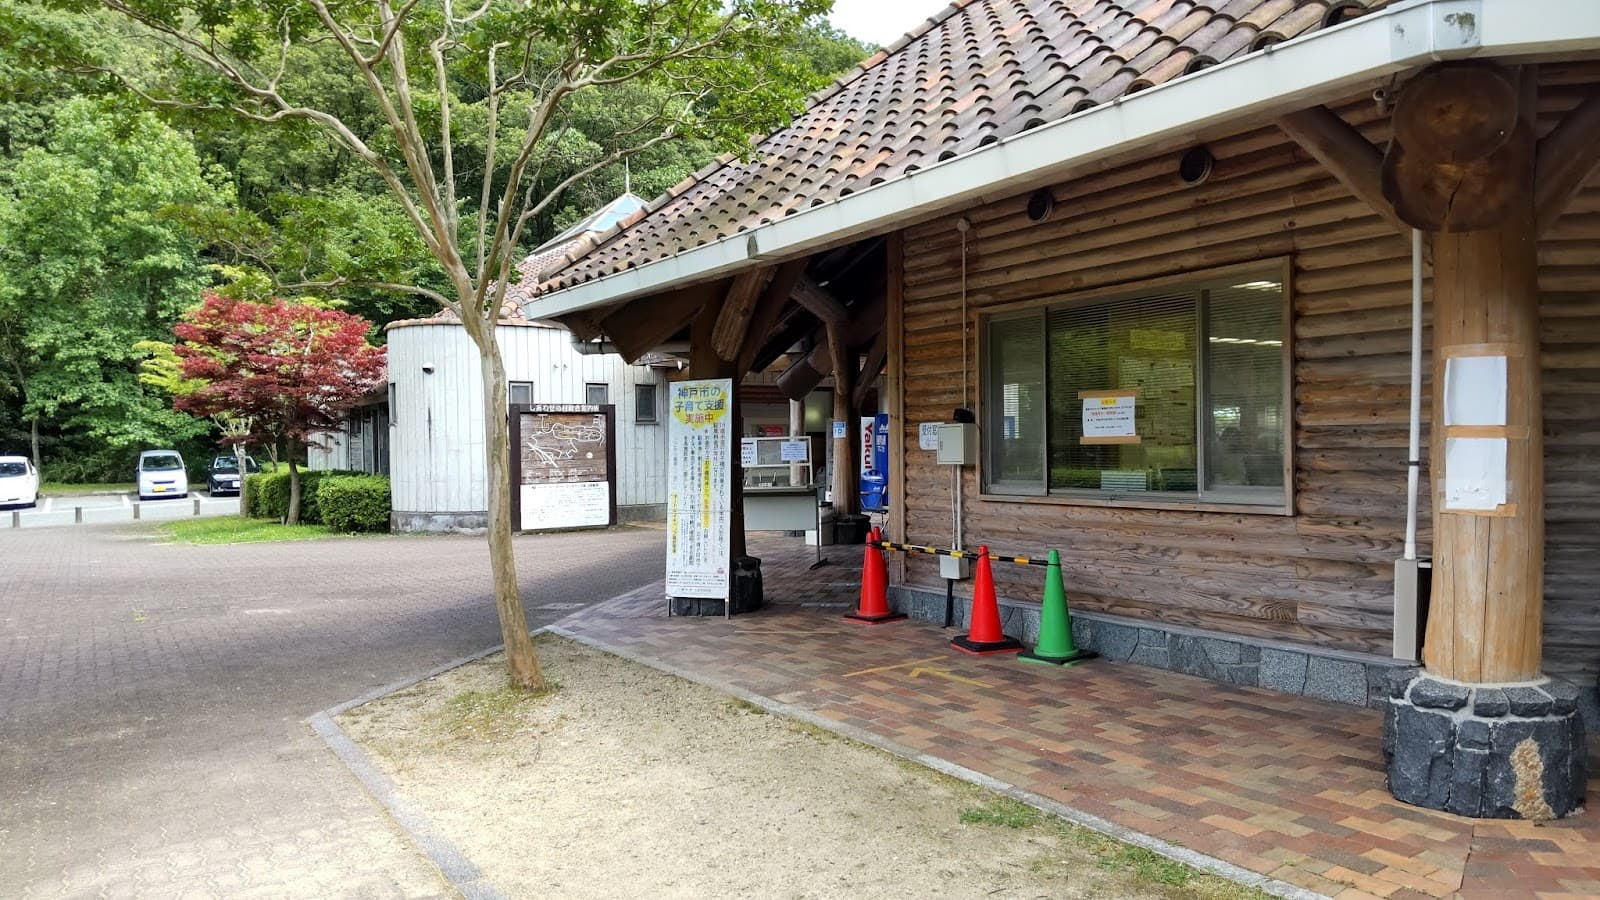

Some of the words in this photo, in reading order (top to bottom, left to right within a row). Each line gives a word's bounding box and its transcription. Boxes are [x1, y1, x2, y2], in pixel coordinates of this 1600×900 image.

[678, 386, 720, 399] 神戸市の
[675, 399, 724, 412] 子育て支援
[686, 413, 714, 424] 実施中
[865, 422, 873, 469] Yakul
